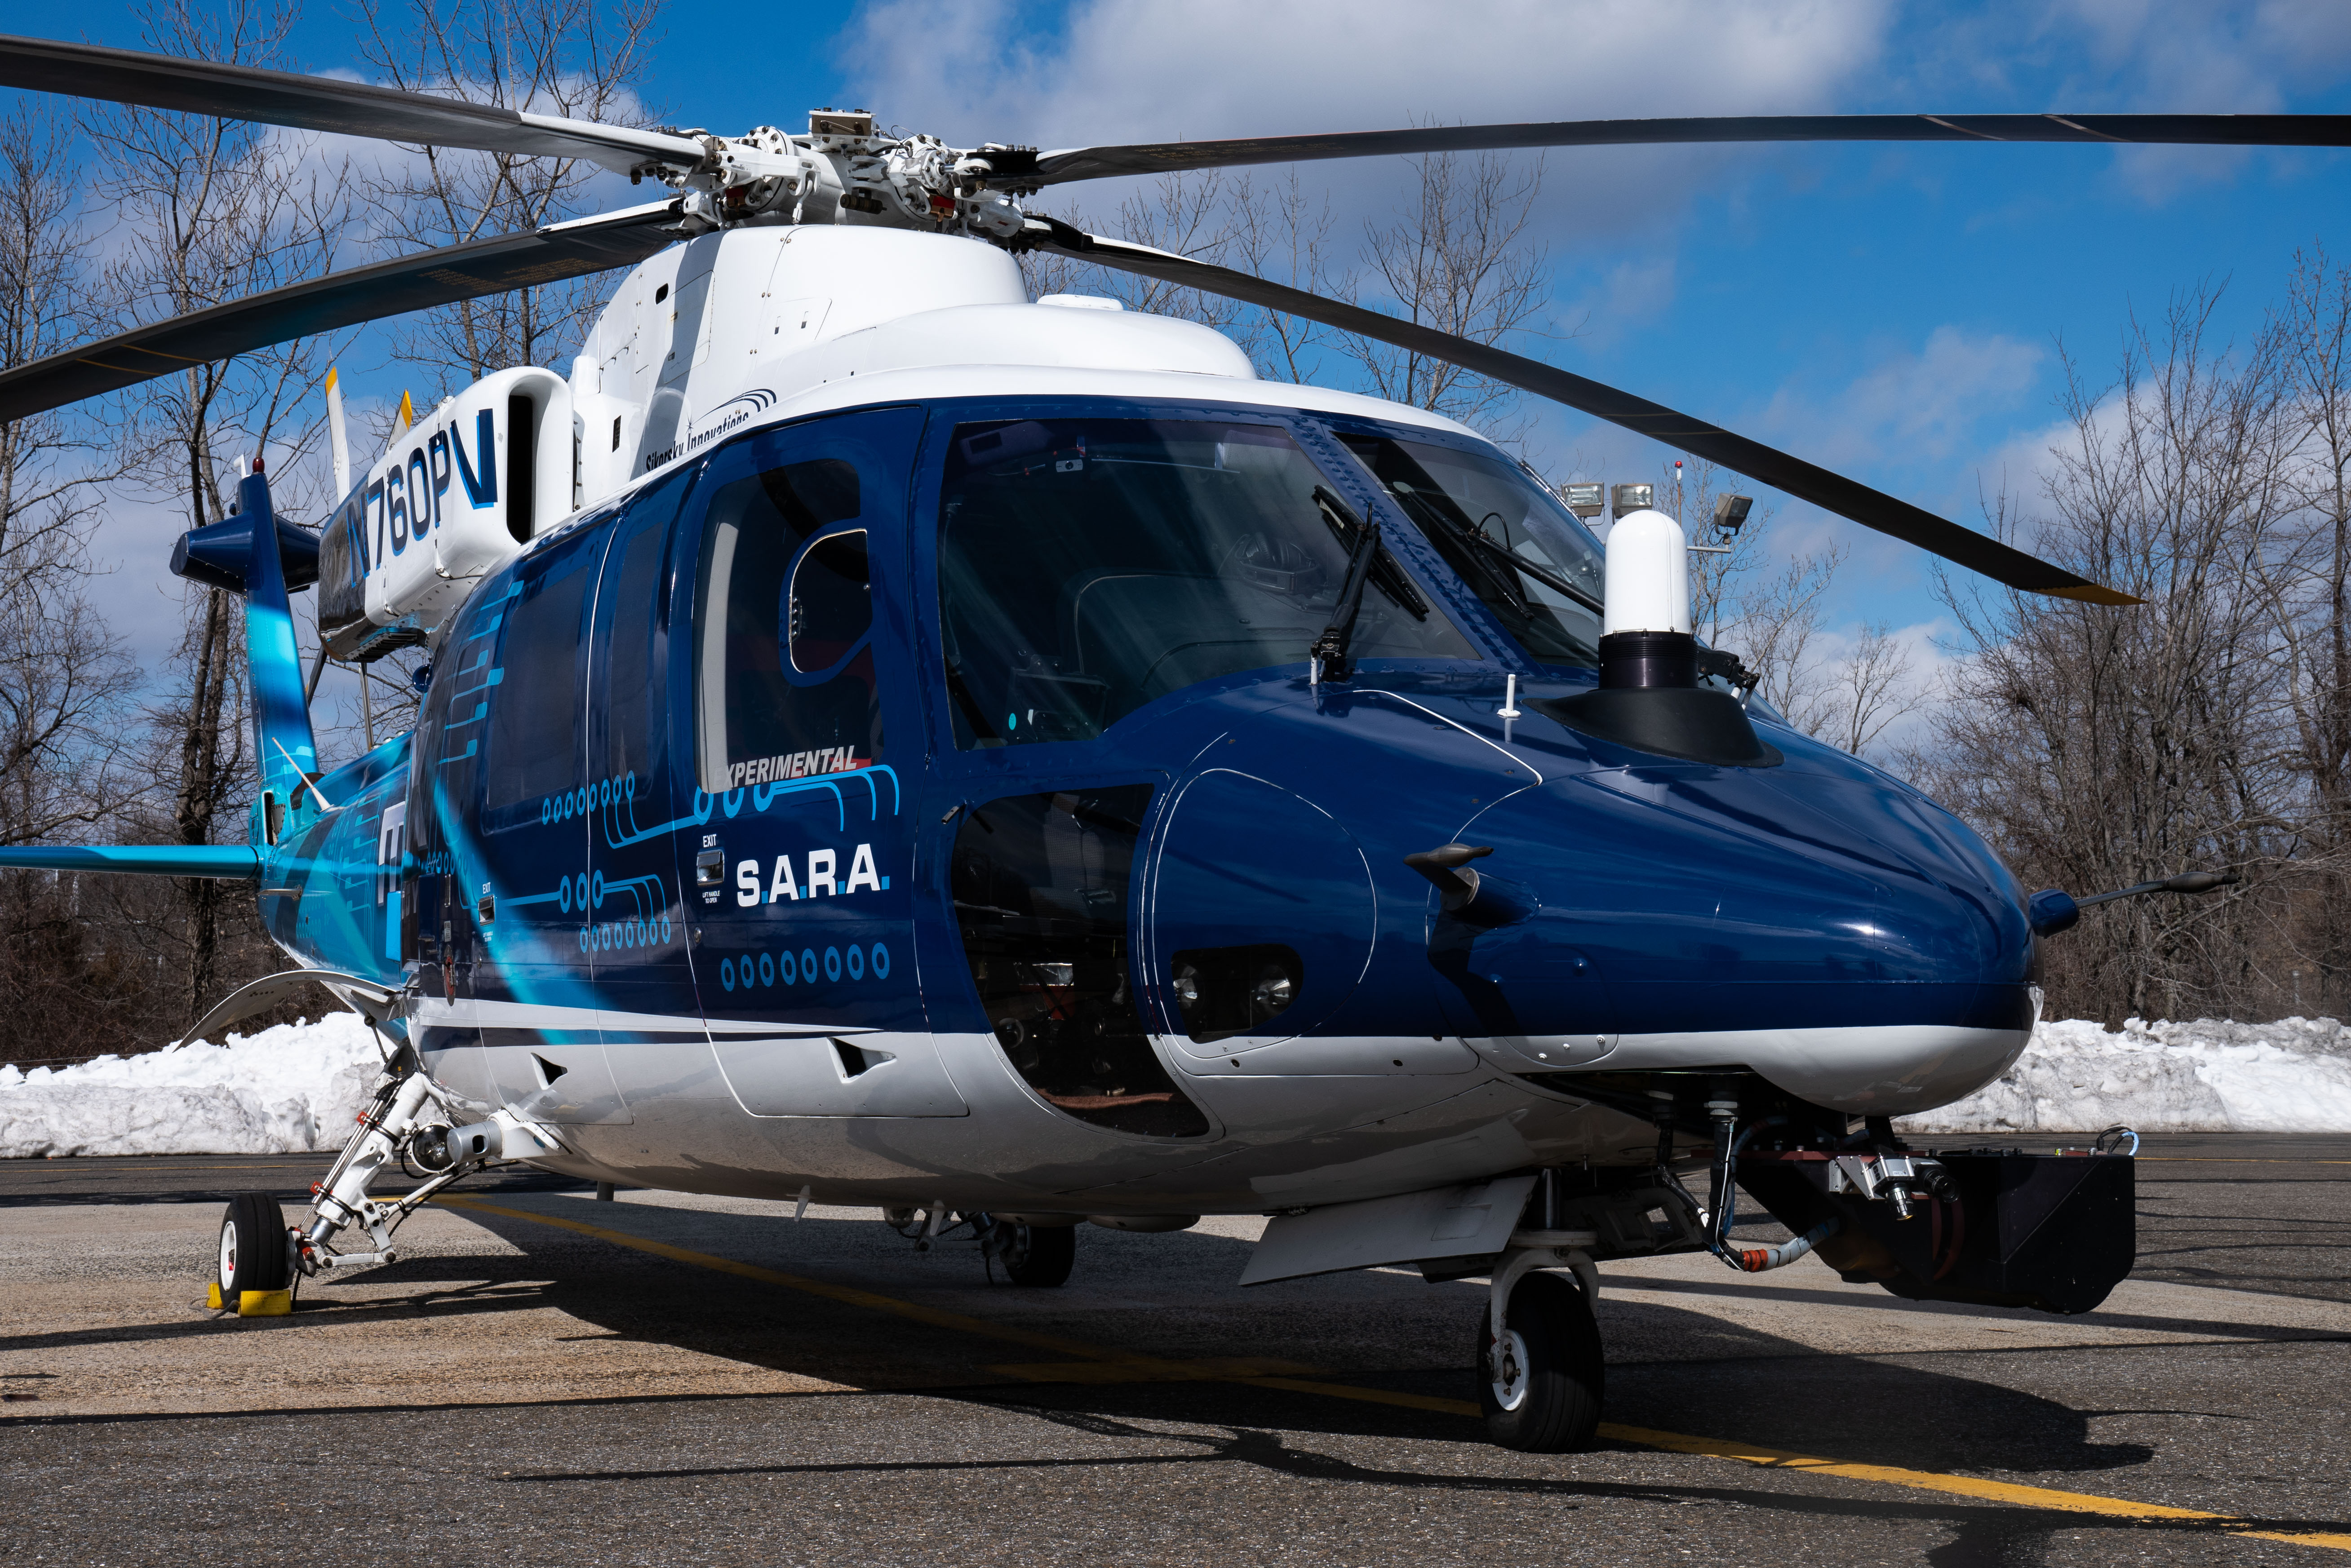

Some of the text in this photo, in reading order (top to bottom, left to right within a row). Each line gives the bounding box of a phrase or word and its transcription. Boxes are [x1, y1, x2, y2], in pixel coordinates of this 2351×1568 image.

[646, 412, 749, 472] Sikorsky Innovations
[346, 408, 498, 588] N760PV
[703, 833, 717, 848] EXIT
[483, 881, 491, 894] EXIT
[737, 843, 890, 907] S.A.R.A.
